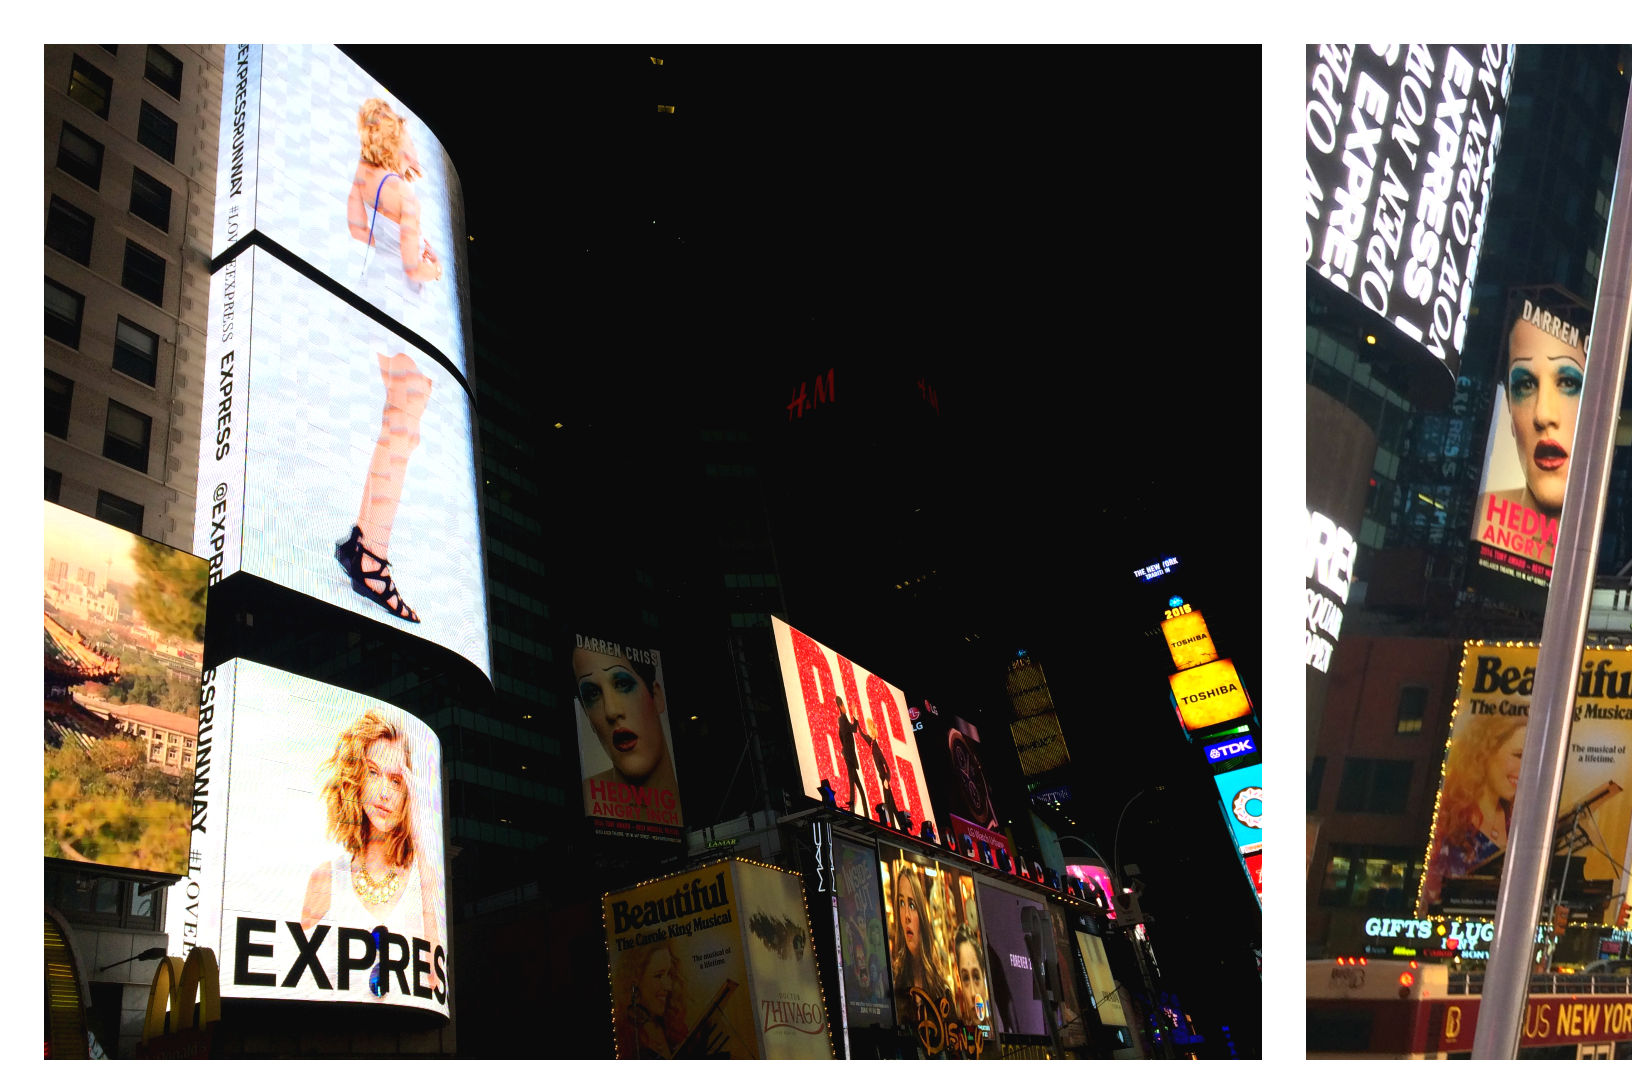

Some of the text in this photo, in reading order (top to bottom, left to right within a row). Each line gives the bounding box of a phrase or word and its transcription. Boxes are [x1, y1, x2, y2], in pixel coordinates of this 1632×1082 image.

[1403, 46, 1473, 306] EXPRESS
[1452, 98, 1487, 246] OPEN
[1360, 158, 1409, 318] OPEN
[1427, 238, 1460, 361] NOW
[1521, 299, 1580, 348] DARREN
[215, 350, 236, 463] EXPRESS
[1483, 525, 1547, 560] ANGRY
[1164, 603, 1193, 621] 2015
[576, 633, 658, 666] DARREN CRISS
[1171, 632, 1208, 649] TOSHIBA
[1181, 683, 1238, 706] TOSHIBA
[1470, 699, 1495, 716] The
[789, 625, 927, 838] BIG
[1223, 739, 1253, 757] TDK
[1571, 744, 1626, 754] The musical of
[590, 778, 676, 811] HEDWIG
[592, 802, 680, 826] ANGRY INCH
[707, 838, 737, 849] LAMAR
[611, 872, 730, 934] Beautiful
[616, 910, 733, 952] The Carole King Musical
[1365, 917, 1433, 939] GIFTS
[233, 916, 450, 1005] EXPRES
[761, 1000, 823, 1032] ZHIVAGO
[1556, 1002, 1600, 1036] NEW
